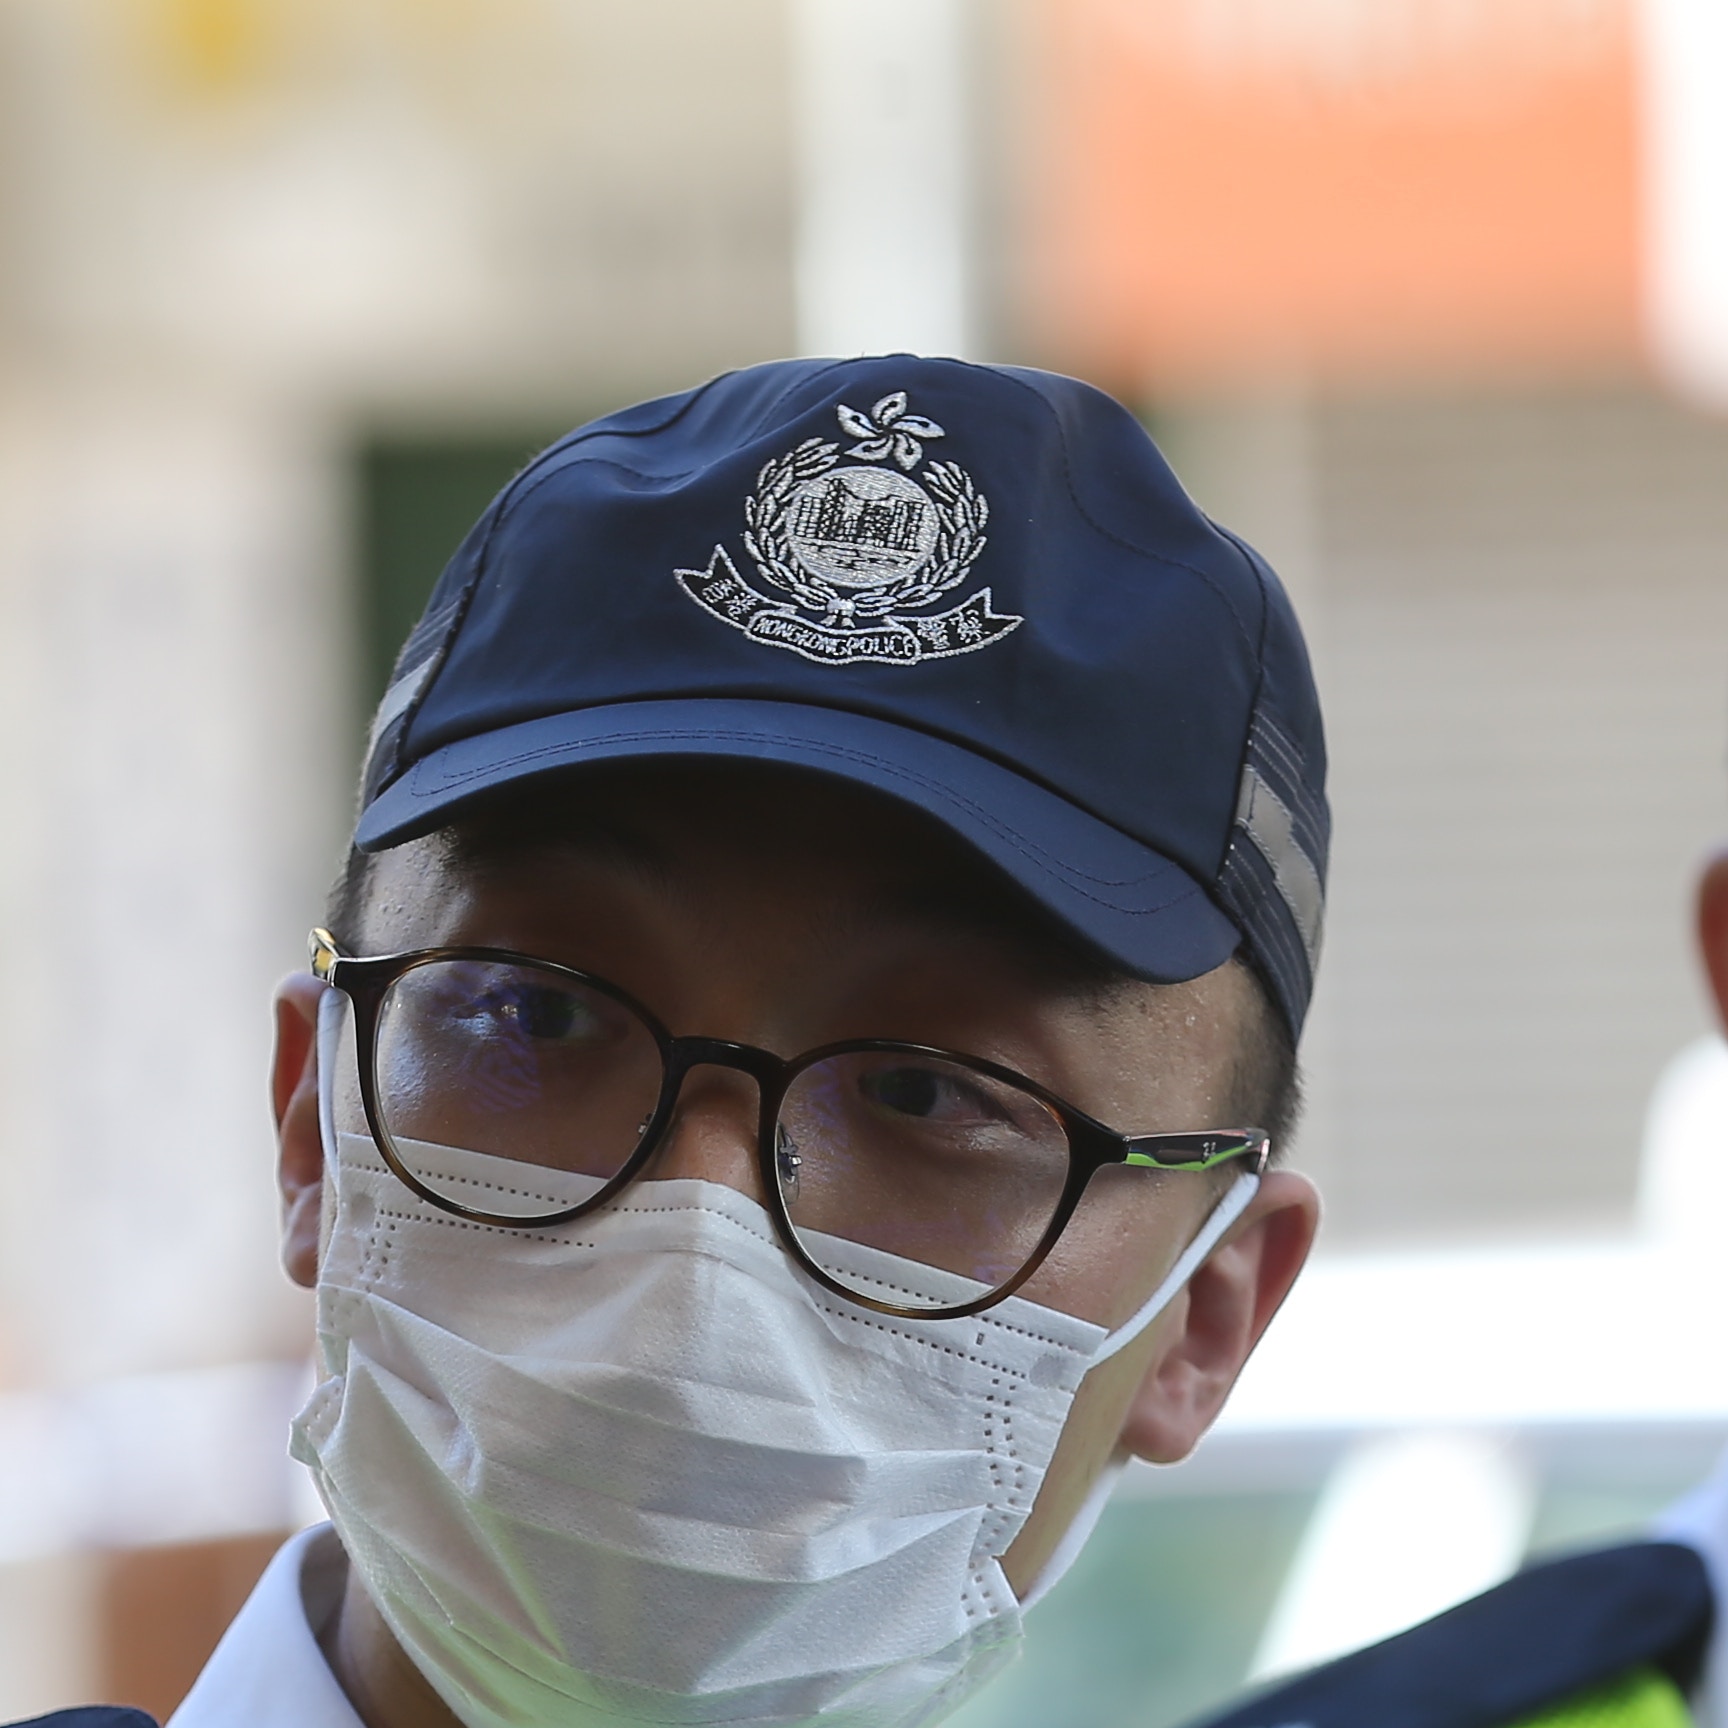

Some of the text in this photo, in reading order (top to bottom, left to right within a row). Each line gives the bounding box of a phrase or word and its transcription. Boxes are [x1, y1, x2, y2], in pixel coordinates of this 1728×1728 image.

[753, 616, 914, 657] HONG KONG POLICE
